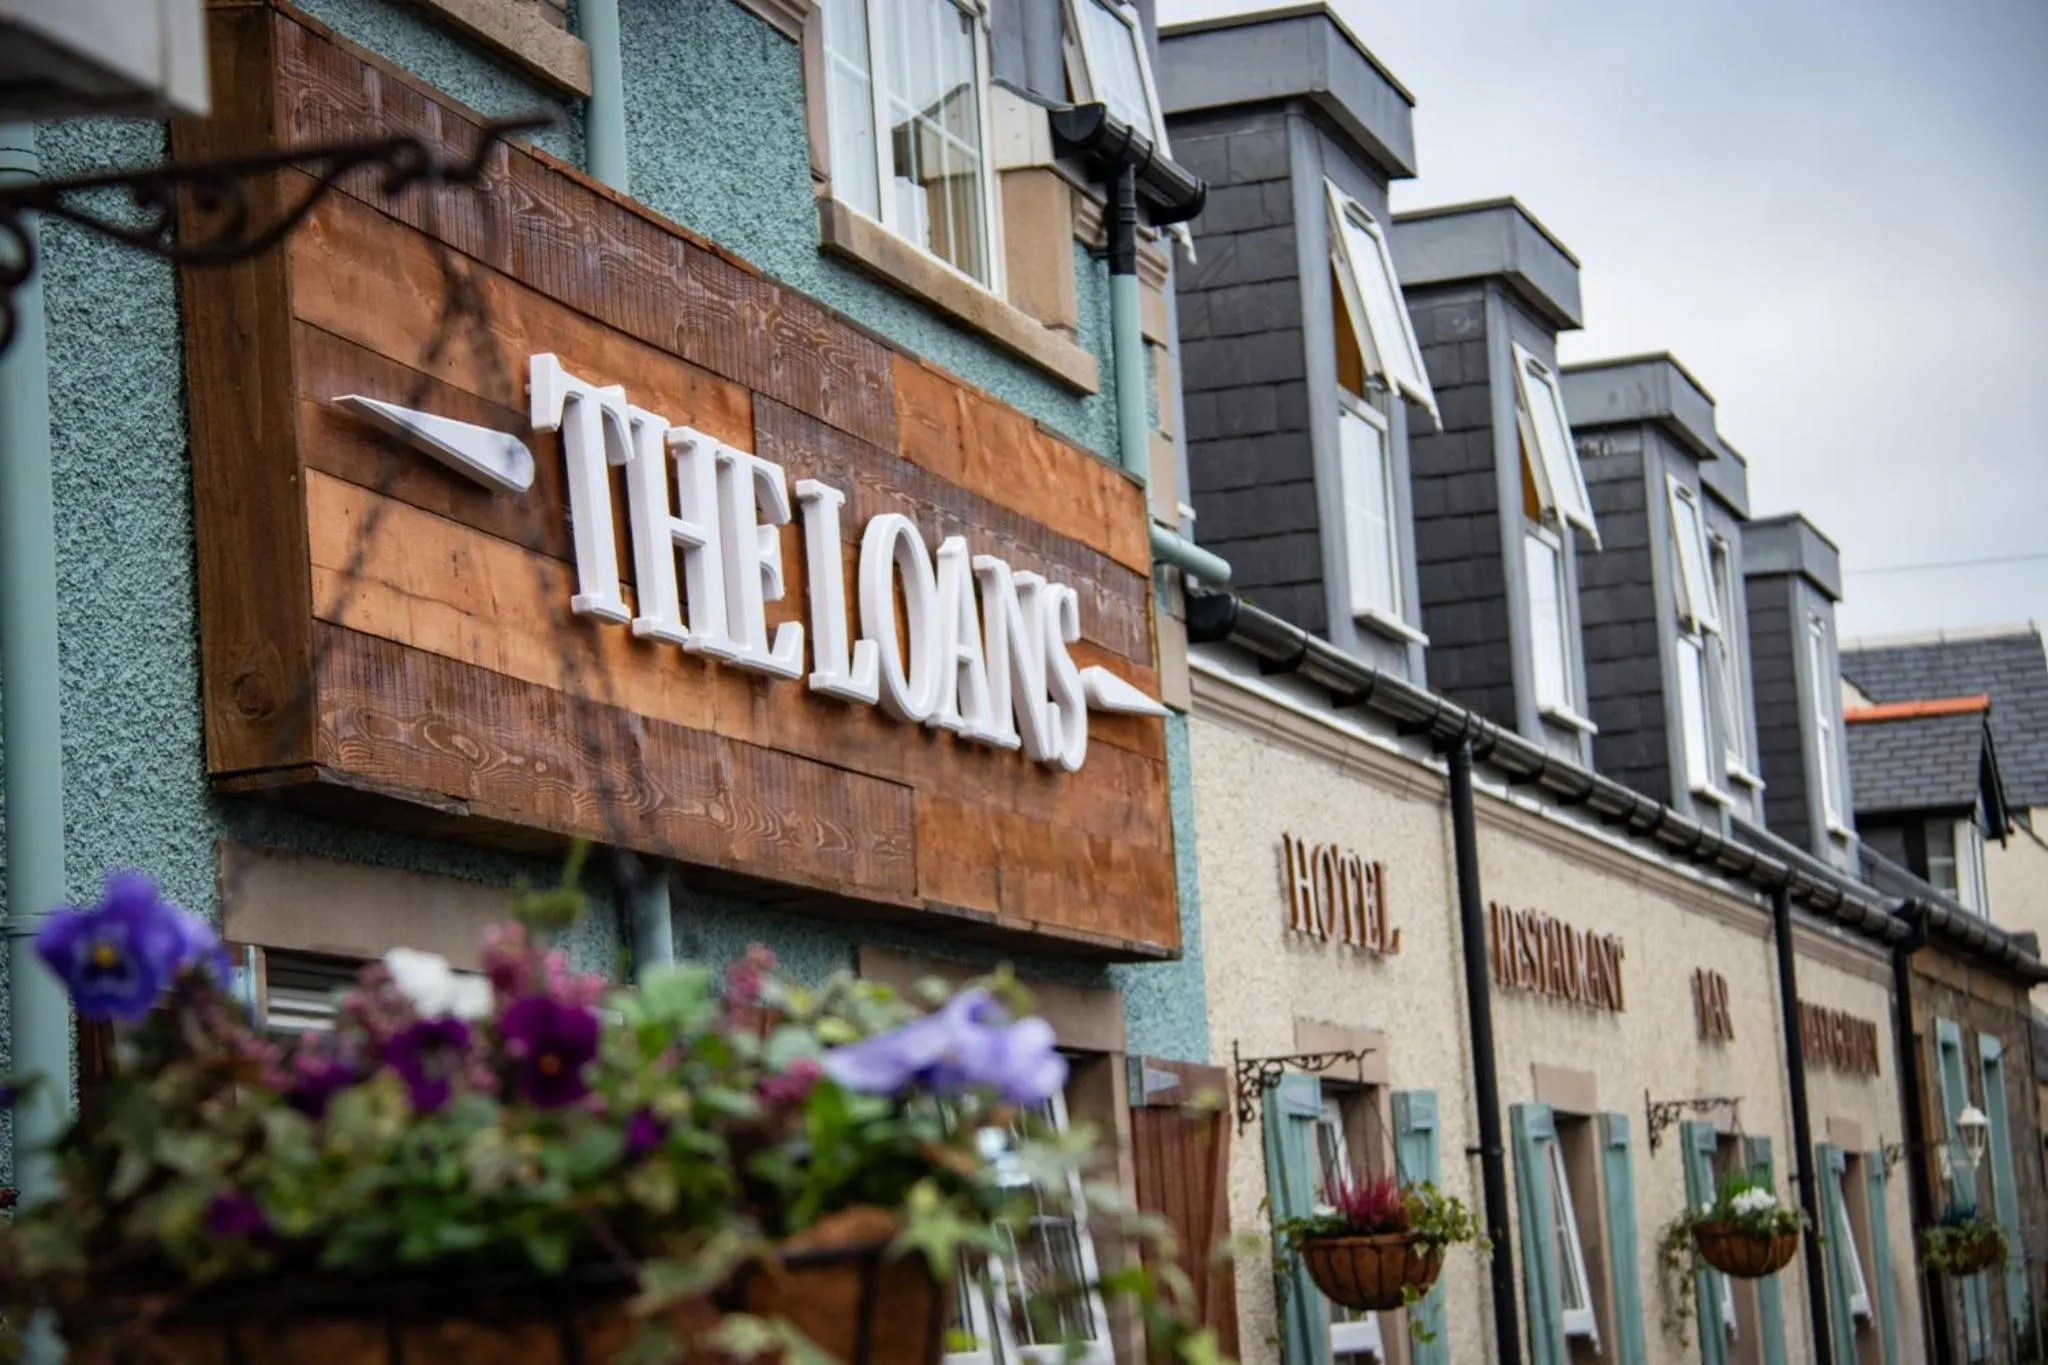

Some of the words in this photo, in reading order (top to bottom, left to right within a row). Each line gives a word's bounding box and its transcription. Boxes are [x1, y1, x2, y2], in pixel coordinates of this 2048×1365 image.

[528, 352, 804, 680] THE
[795, 478, 1089, 773] LOANS
[1282, 832, 1400, 955] HOTEL
[1490, 900, 1625, 1013] RESTAURANT
